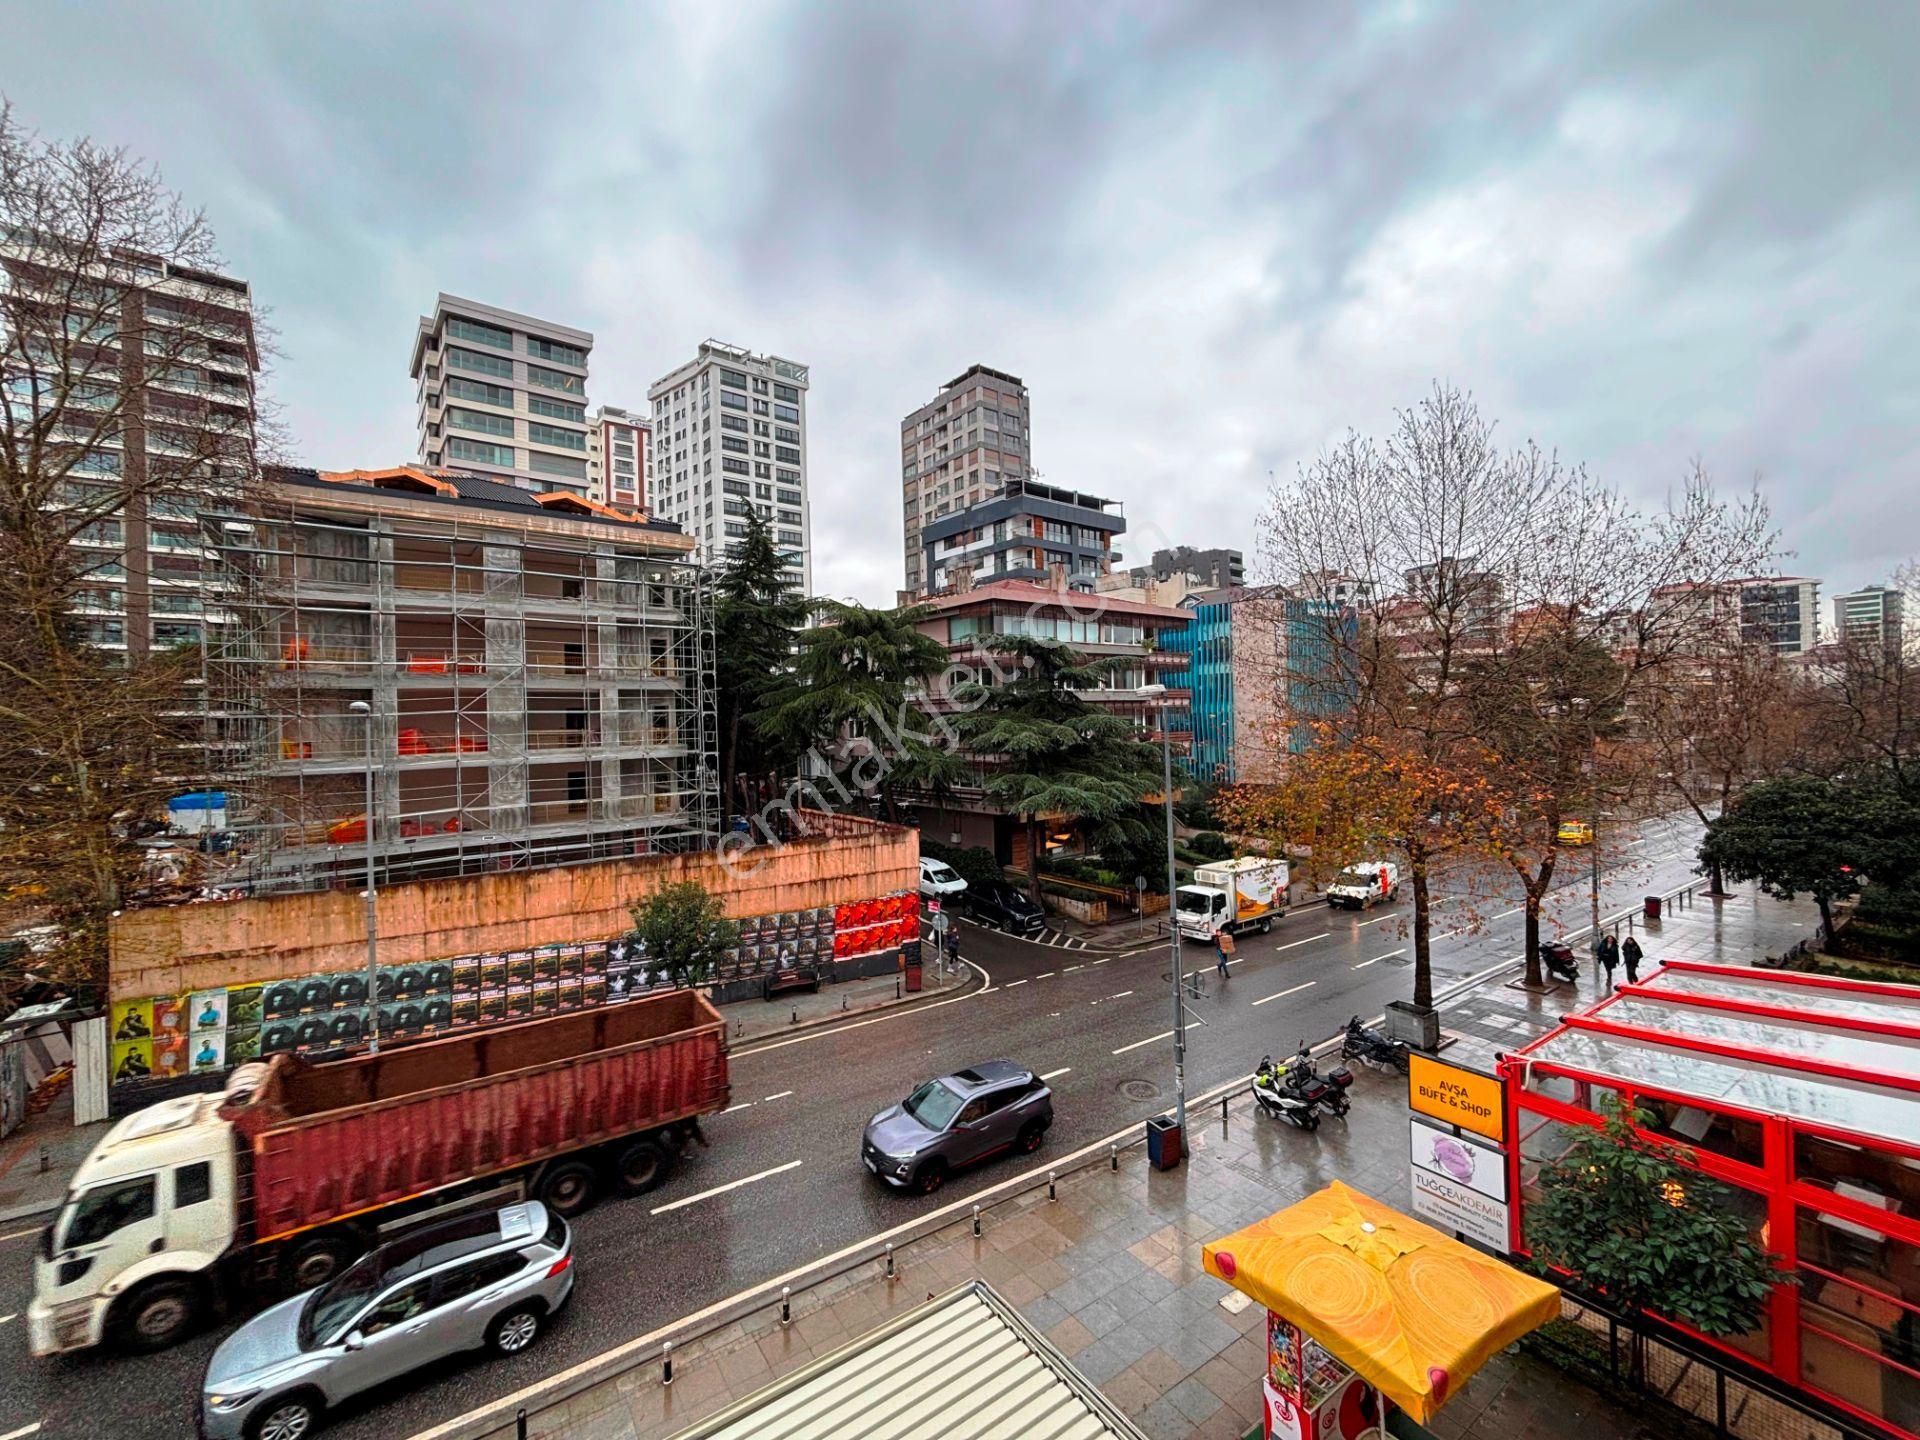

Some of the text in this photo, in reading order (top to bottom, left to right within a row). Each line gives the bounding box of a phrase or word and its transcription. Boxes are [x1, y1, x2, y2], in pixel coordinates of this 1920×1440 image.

[1419, 1085, 1491, 1118] BÜFE & SHOP
[1439, 1081, 1469, 1098] AVŞA
